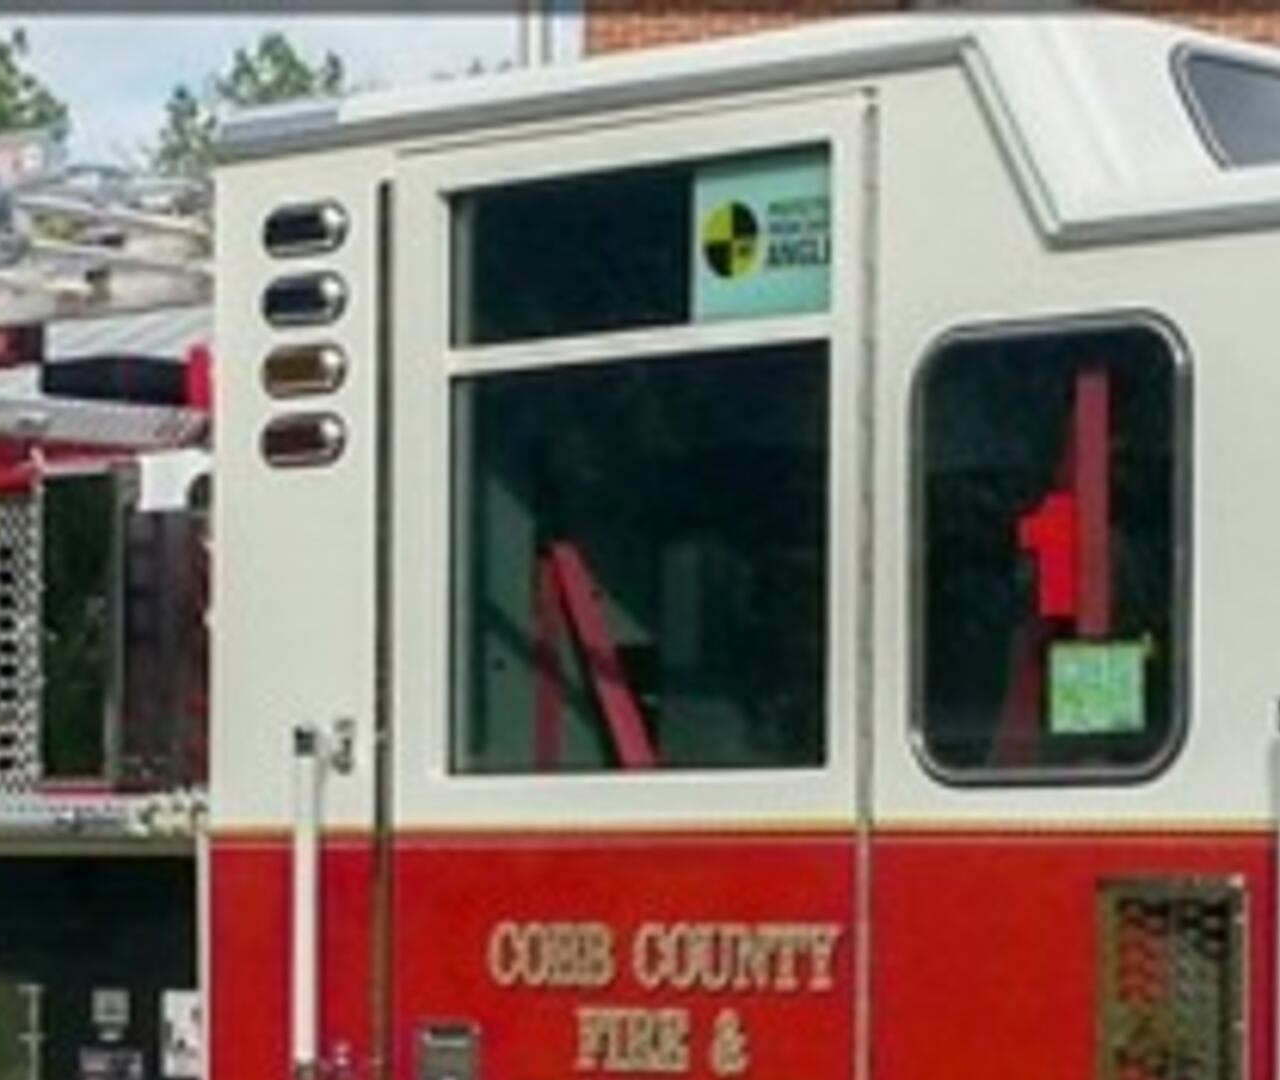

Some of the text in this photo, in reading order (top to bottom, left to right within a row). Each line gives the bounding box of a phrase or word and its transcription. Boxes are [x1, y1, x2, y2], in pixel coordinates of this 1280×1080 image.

[488, 921, 841, 990] COBB COUNTY
[574, 1008, 750, 1078] FIRE &
